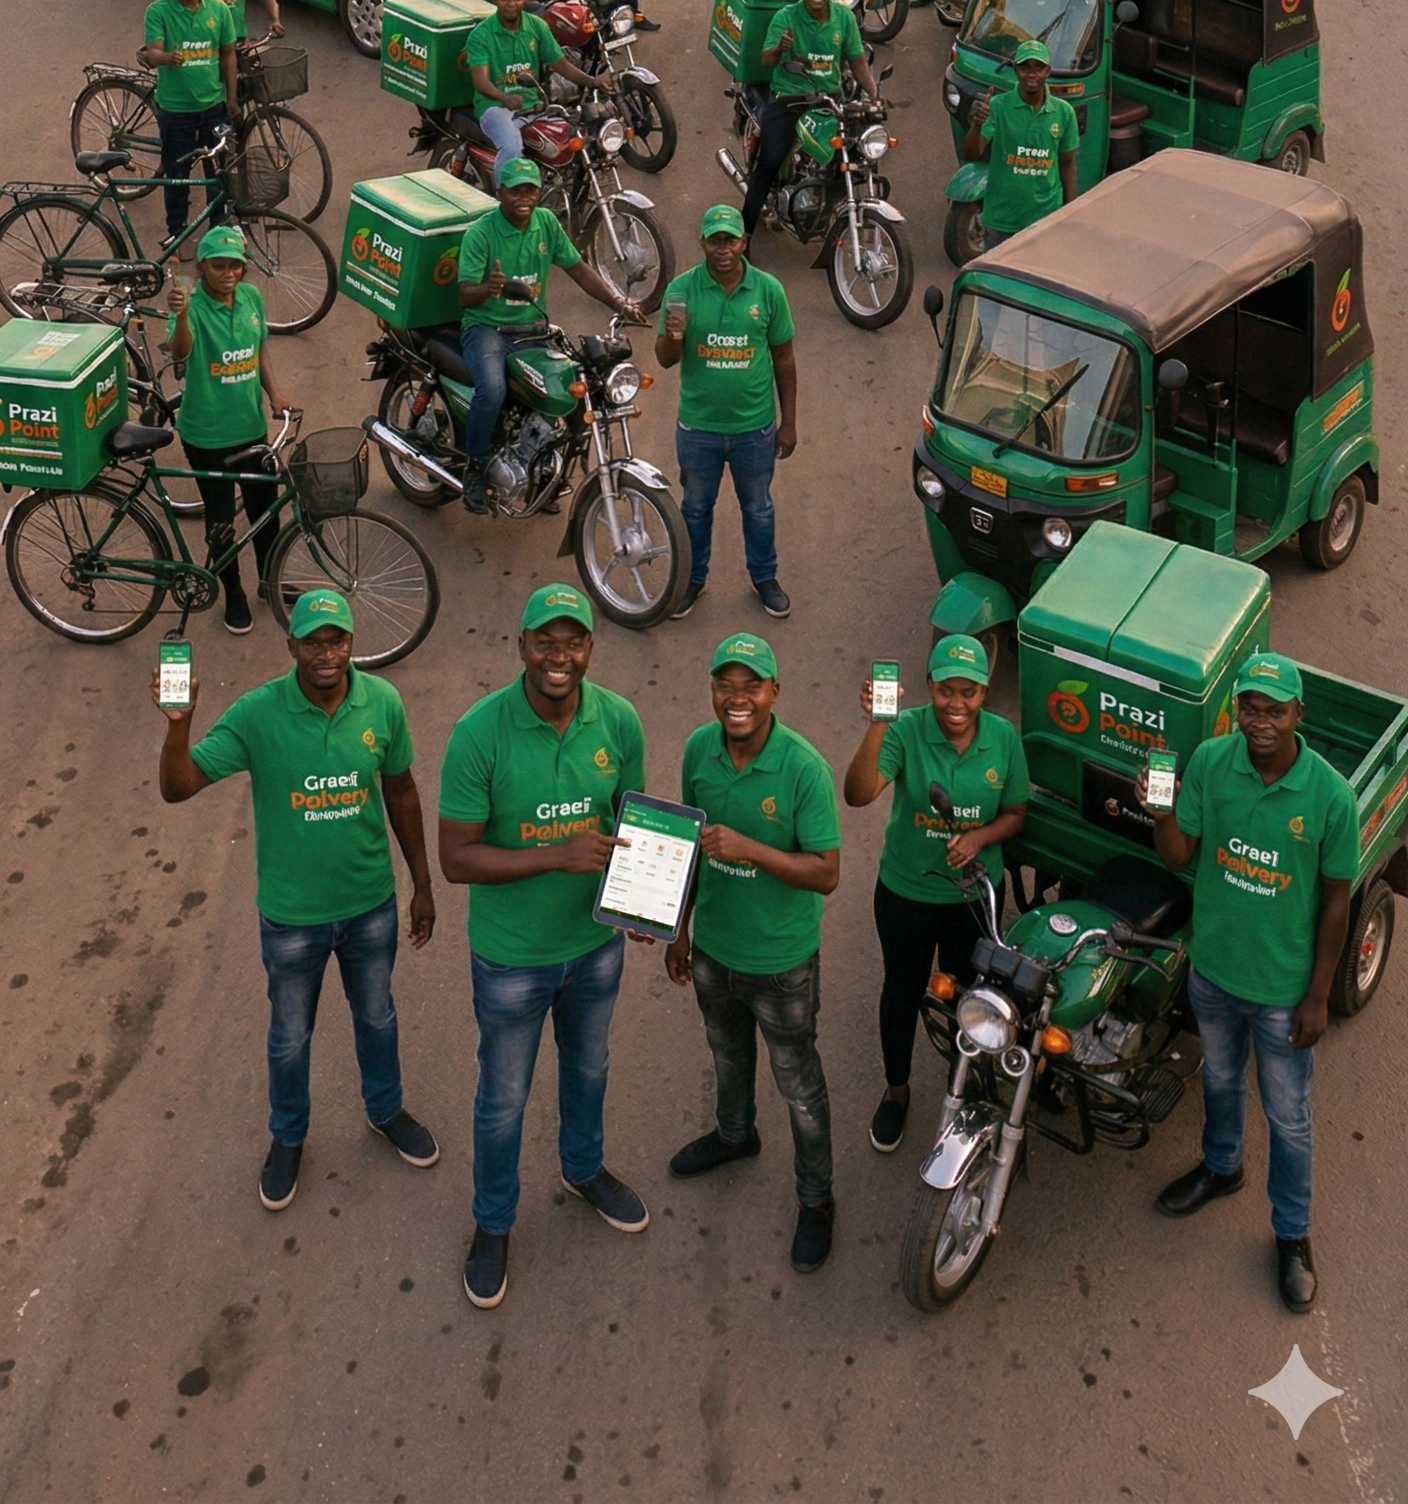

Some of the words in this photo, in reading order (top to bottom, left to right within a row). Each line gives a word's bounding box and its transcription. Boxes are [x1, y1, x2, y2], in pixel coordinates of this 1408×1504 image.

[372, 232, 403, 263] Prazi
[9, 403, 57, 423] Prazi
[10, 419, 59, 439] Point
[1100, 691, 1166, 731] Prazi
[1100, 712, 1167, 750] Point
[291, 788, 369, 810] Polvery
